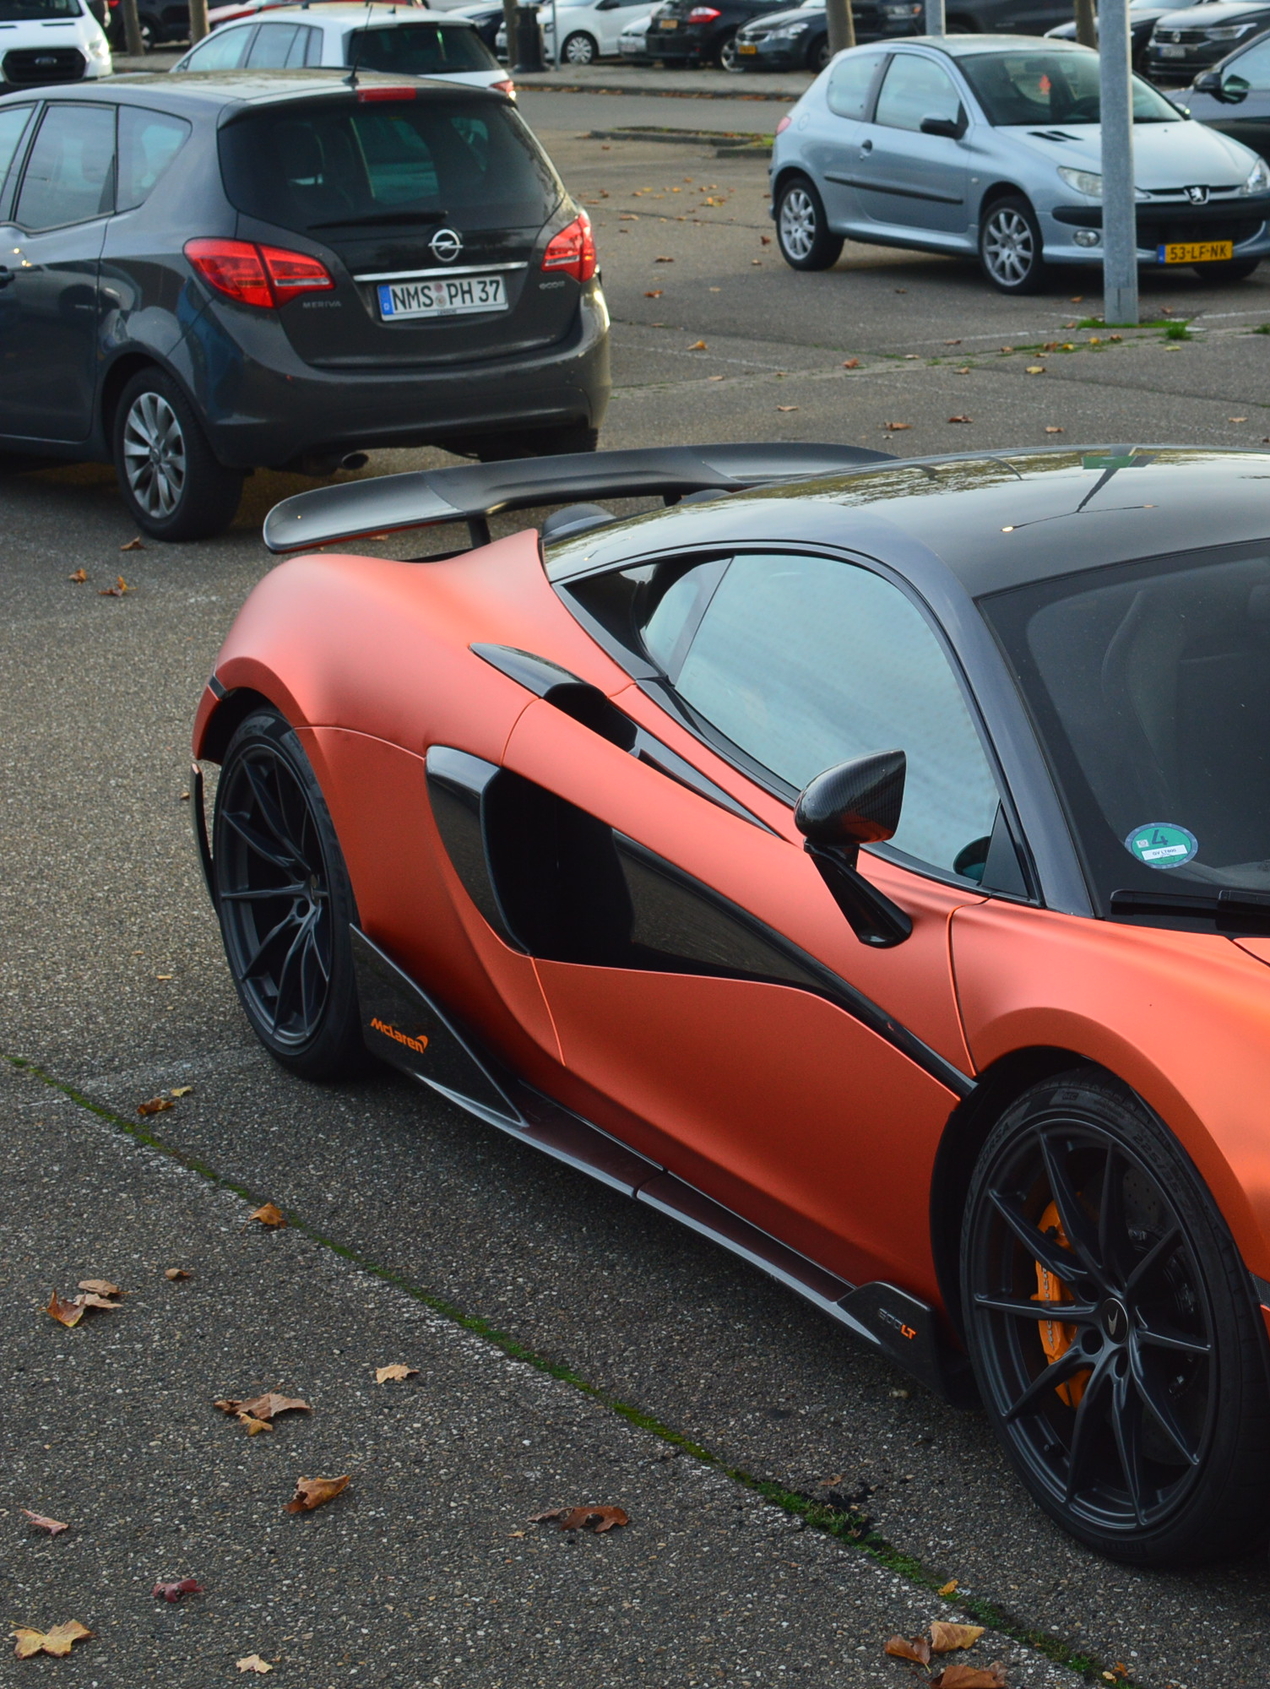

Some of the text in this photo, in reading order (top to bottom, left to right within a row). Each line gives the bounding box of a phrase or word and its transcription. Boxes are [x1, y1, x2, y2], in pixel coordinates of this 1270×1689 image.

[1170, 245, 1226, 260] 53-LF-NK
[392, 285, 434, 310] NMS
[446, 282, 474, 306] PH
[477, 280, 500, 302] 37
[1152, 829, 1168, 846] 4
[370, 1017, 427, 1054] McLaren
